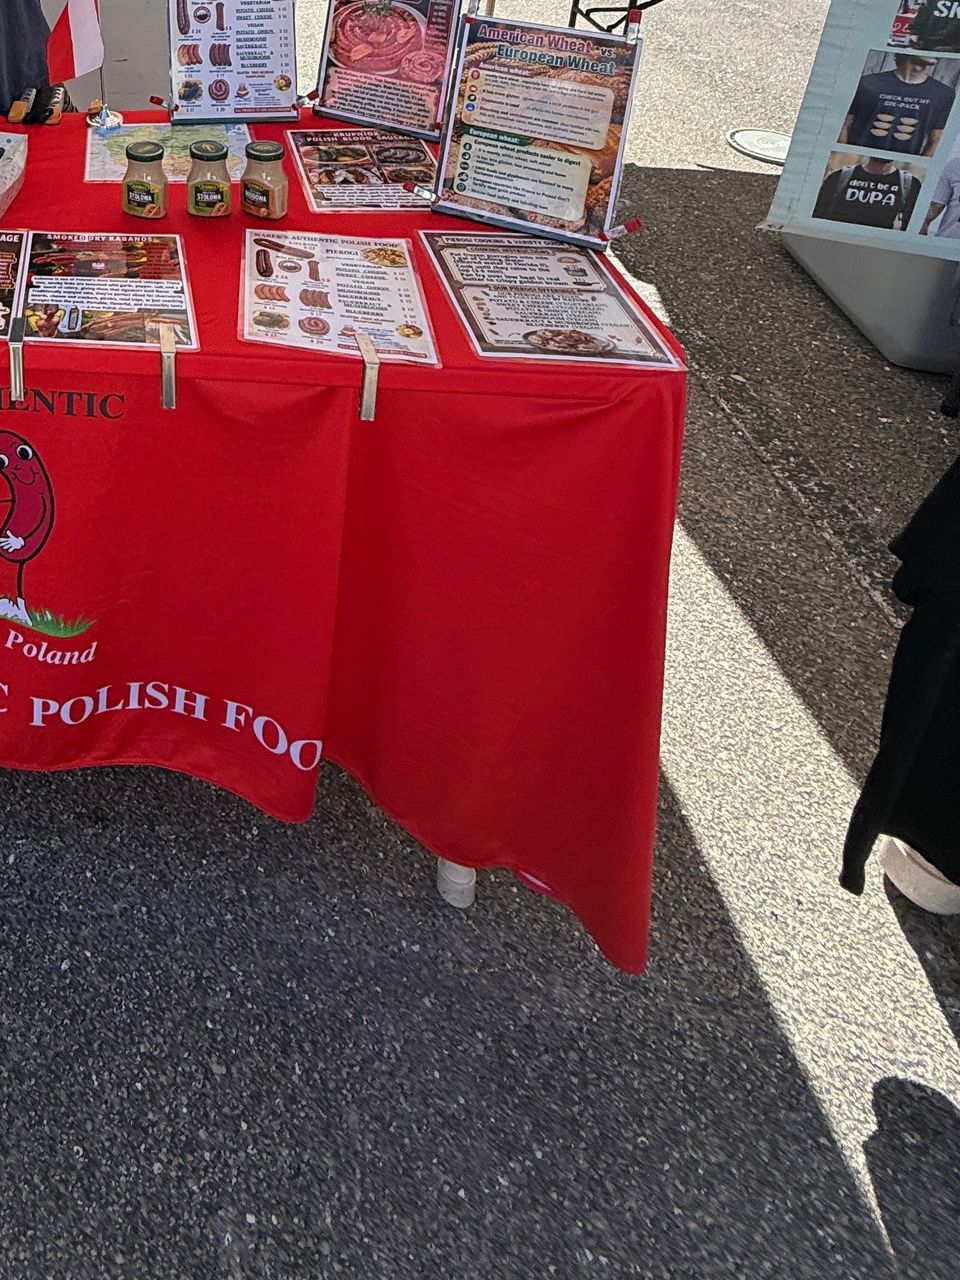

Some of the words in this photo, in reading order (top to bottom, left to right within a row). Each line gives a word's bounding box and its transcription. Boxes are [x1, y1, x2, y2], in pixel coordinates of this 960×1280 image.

[478, 23, 545, 47] American
[547, 34, 593, 55] Wheat
[600, 46, 616, 59] vs.
[496, 43, 564, 68] European
[568, 55, 617, 76] Wheat
[479, 61, 508, 74] American
[878, 93, 903, 102] CHECK
[903, 96, 920, 104] OUT
[883, 100, 921, 111] SIX-PACK
[469, 127, 499, 141] European
[474, 138, 499, 150] European
[499, 143, 516, 153] wheat
[516, 148, 540, 159] products
[539, 151, 557, 162] easier
[563, 157, 582, 168] digest
[876, 182, 890, 192] be
[845, 188, 896, 207] DUPA
[46, 233, 88, 241] SMOKED
[87, 234, 106, 242] DRY
[108, 235, 154, 243] KABANOS
[291, 235, 340, 245] AUTHENTIC
[340, 239, 372, 247] POLISH
[444, 236, 474, 245] PIEROGI
[475, 237, 507, 246] COOKING
[513, 239, 542, 248] VARIETY
[325, 248, 359, 257] PIEROGI
[5, 630, 98, 666] Poland
[28, 681, 211, 727] POLISH
[221, 699, 323, 772] FOO
